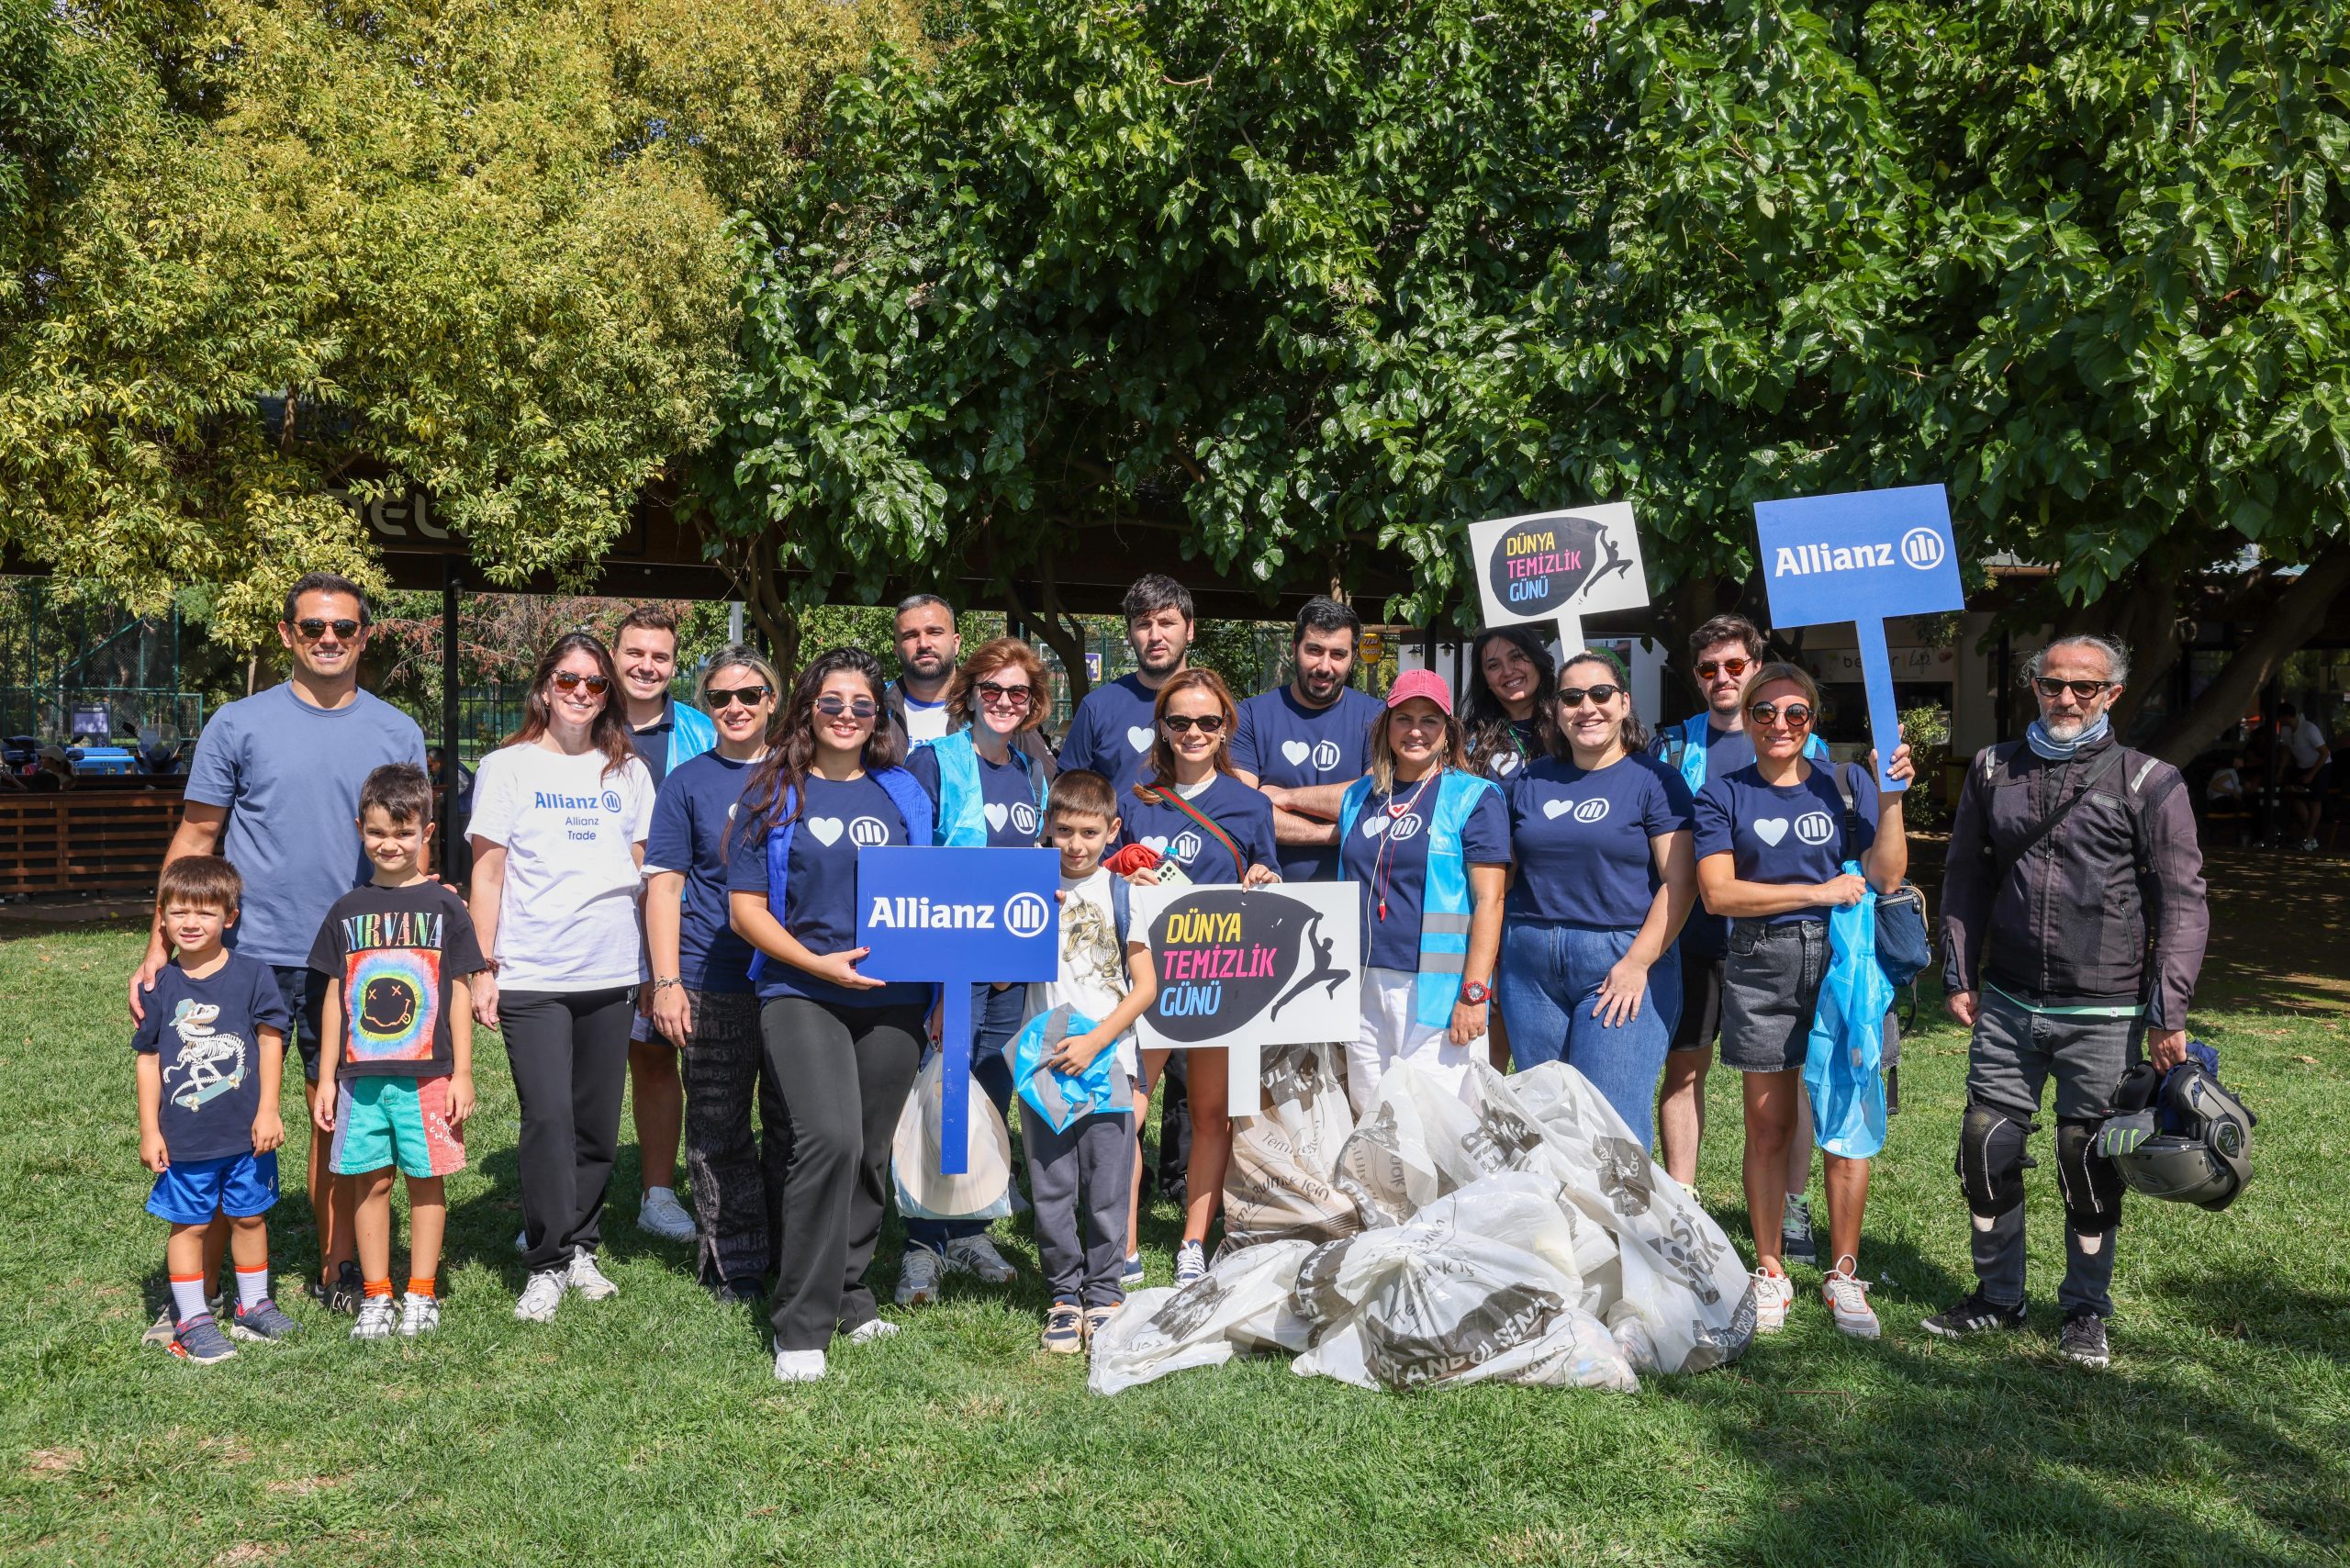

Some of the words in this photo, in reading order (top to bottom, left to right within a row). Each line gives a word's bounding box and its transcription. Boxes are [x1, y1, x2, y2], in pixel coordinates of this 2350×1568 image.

[1506, 532, 1556, 556] DÜNYA
[1506, 549, 1582, 579] TEMİZLİK
[1774, 543, 1895, 577] Allianz
[1509, 575, 1549, 602] GÜNÜ
[534, 791, 599, 809] Allianz
[565, 816, 599, 826] Allianz
[567, 831, 597, 840] Trade
[867, 897, 995, 929] Allianz
[1166, 908, 1241, 944] DÜNYA
[341, 912, 442, 953] NIRVANA
[1163, 943, 1278, 980] TEMİZLİK
[1159, 980, 1222, 1016] GÜNÜ
